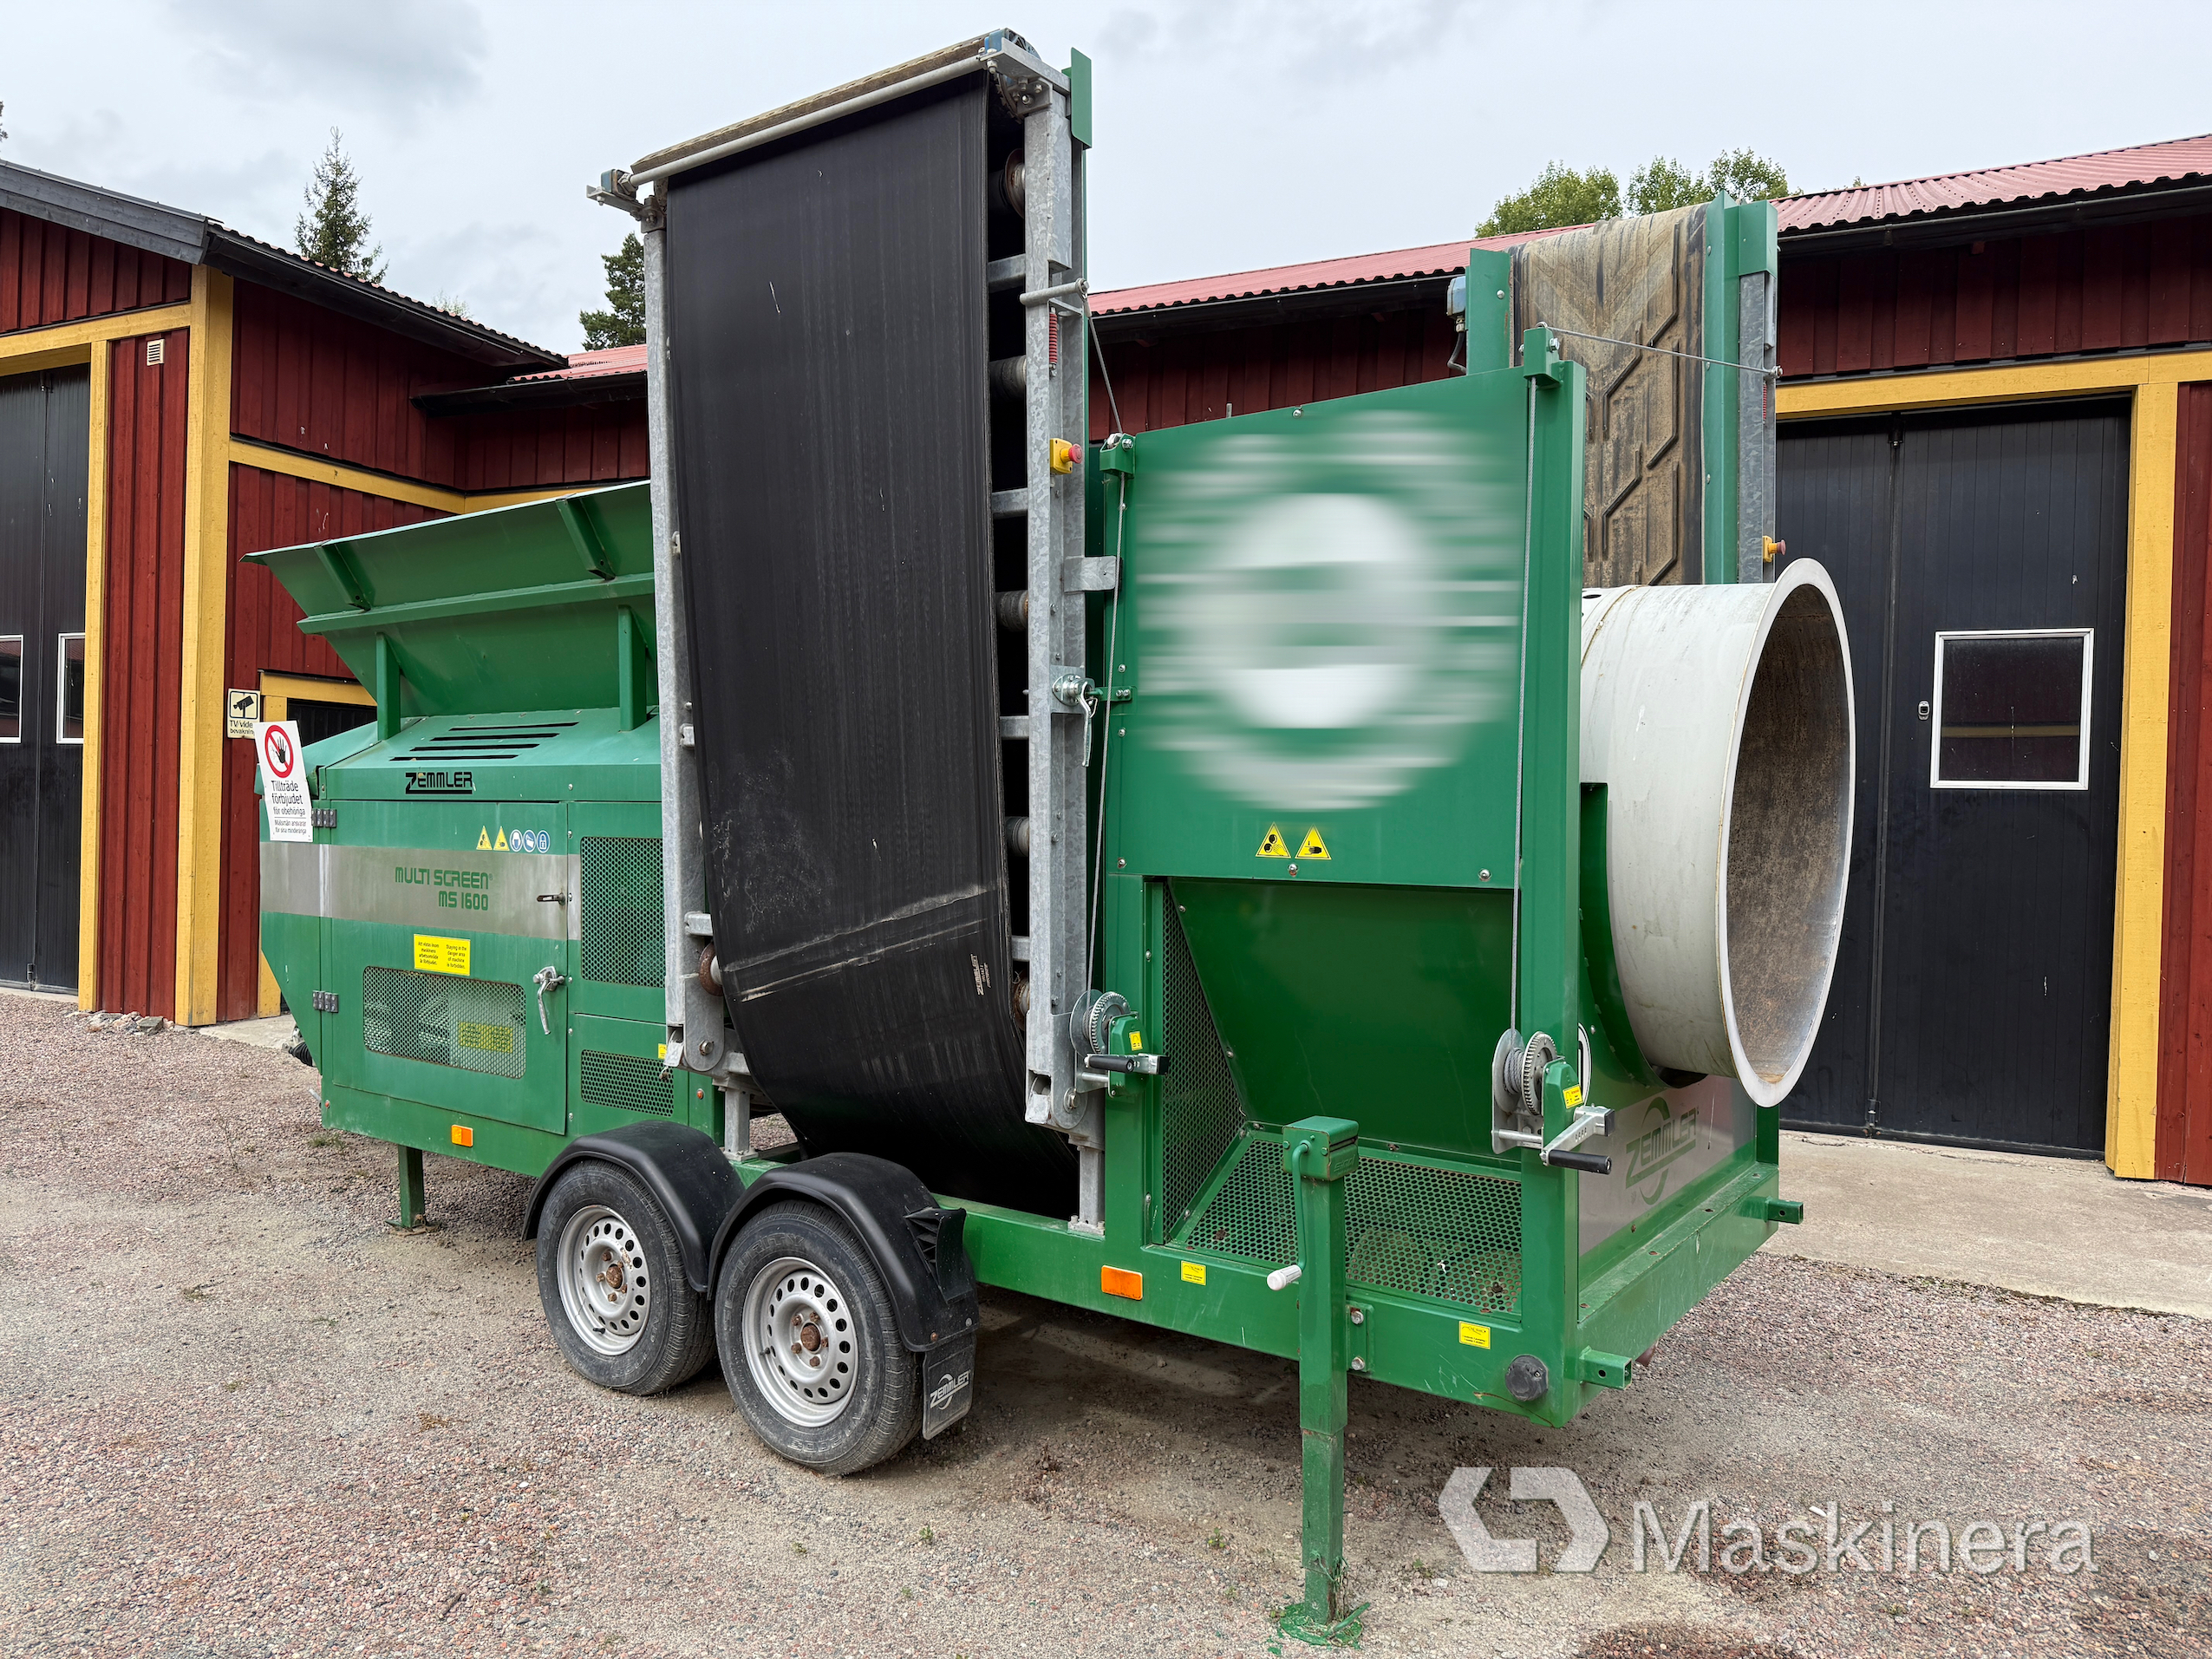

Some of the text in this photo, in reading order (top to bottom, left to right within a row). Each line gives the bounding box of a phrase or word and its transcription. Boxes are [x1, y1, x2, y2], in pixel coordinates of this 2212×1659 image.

[271, 780, 299, 791] Tillträde
[405, 771, 473, 794] ZEMMLER
[271, 793, 303, 807] förbjudet
[281, 807, 305, 817] obehöriga
[395, 866, 429, 885] MULTI
[439, 890, 489, 911] MS 1600
[1625, 1107, 1696, 1189] ZEMMLER
[722, 1232, 805, 1331] SECURITY
[930, 1370, 969, 1408] ZEMMLER
